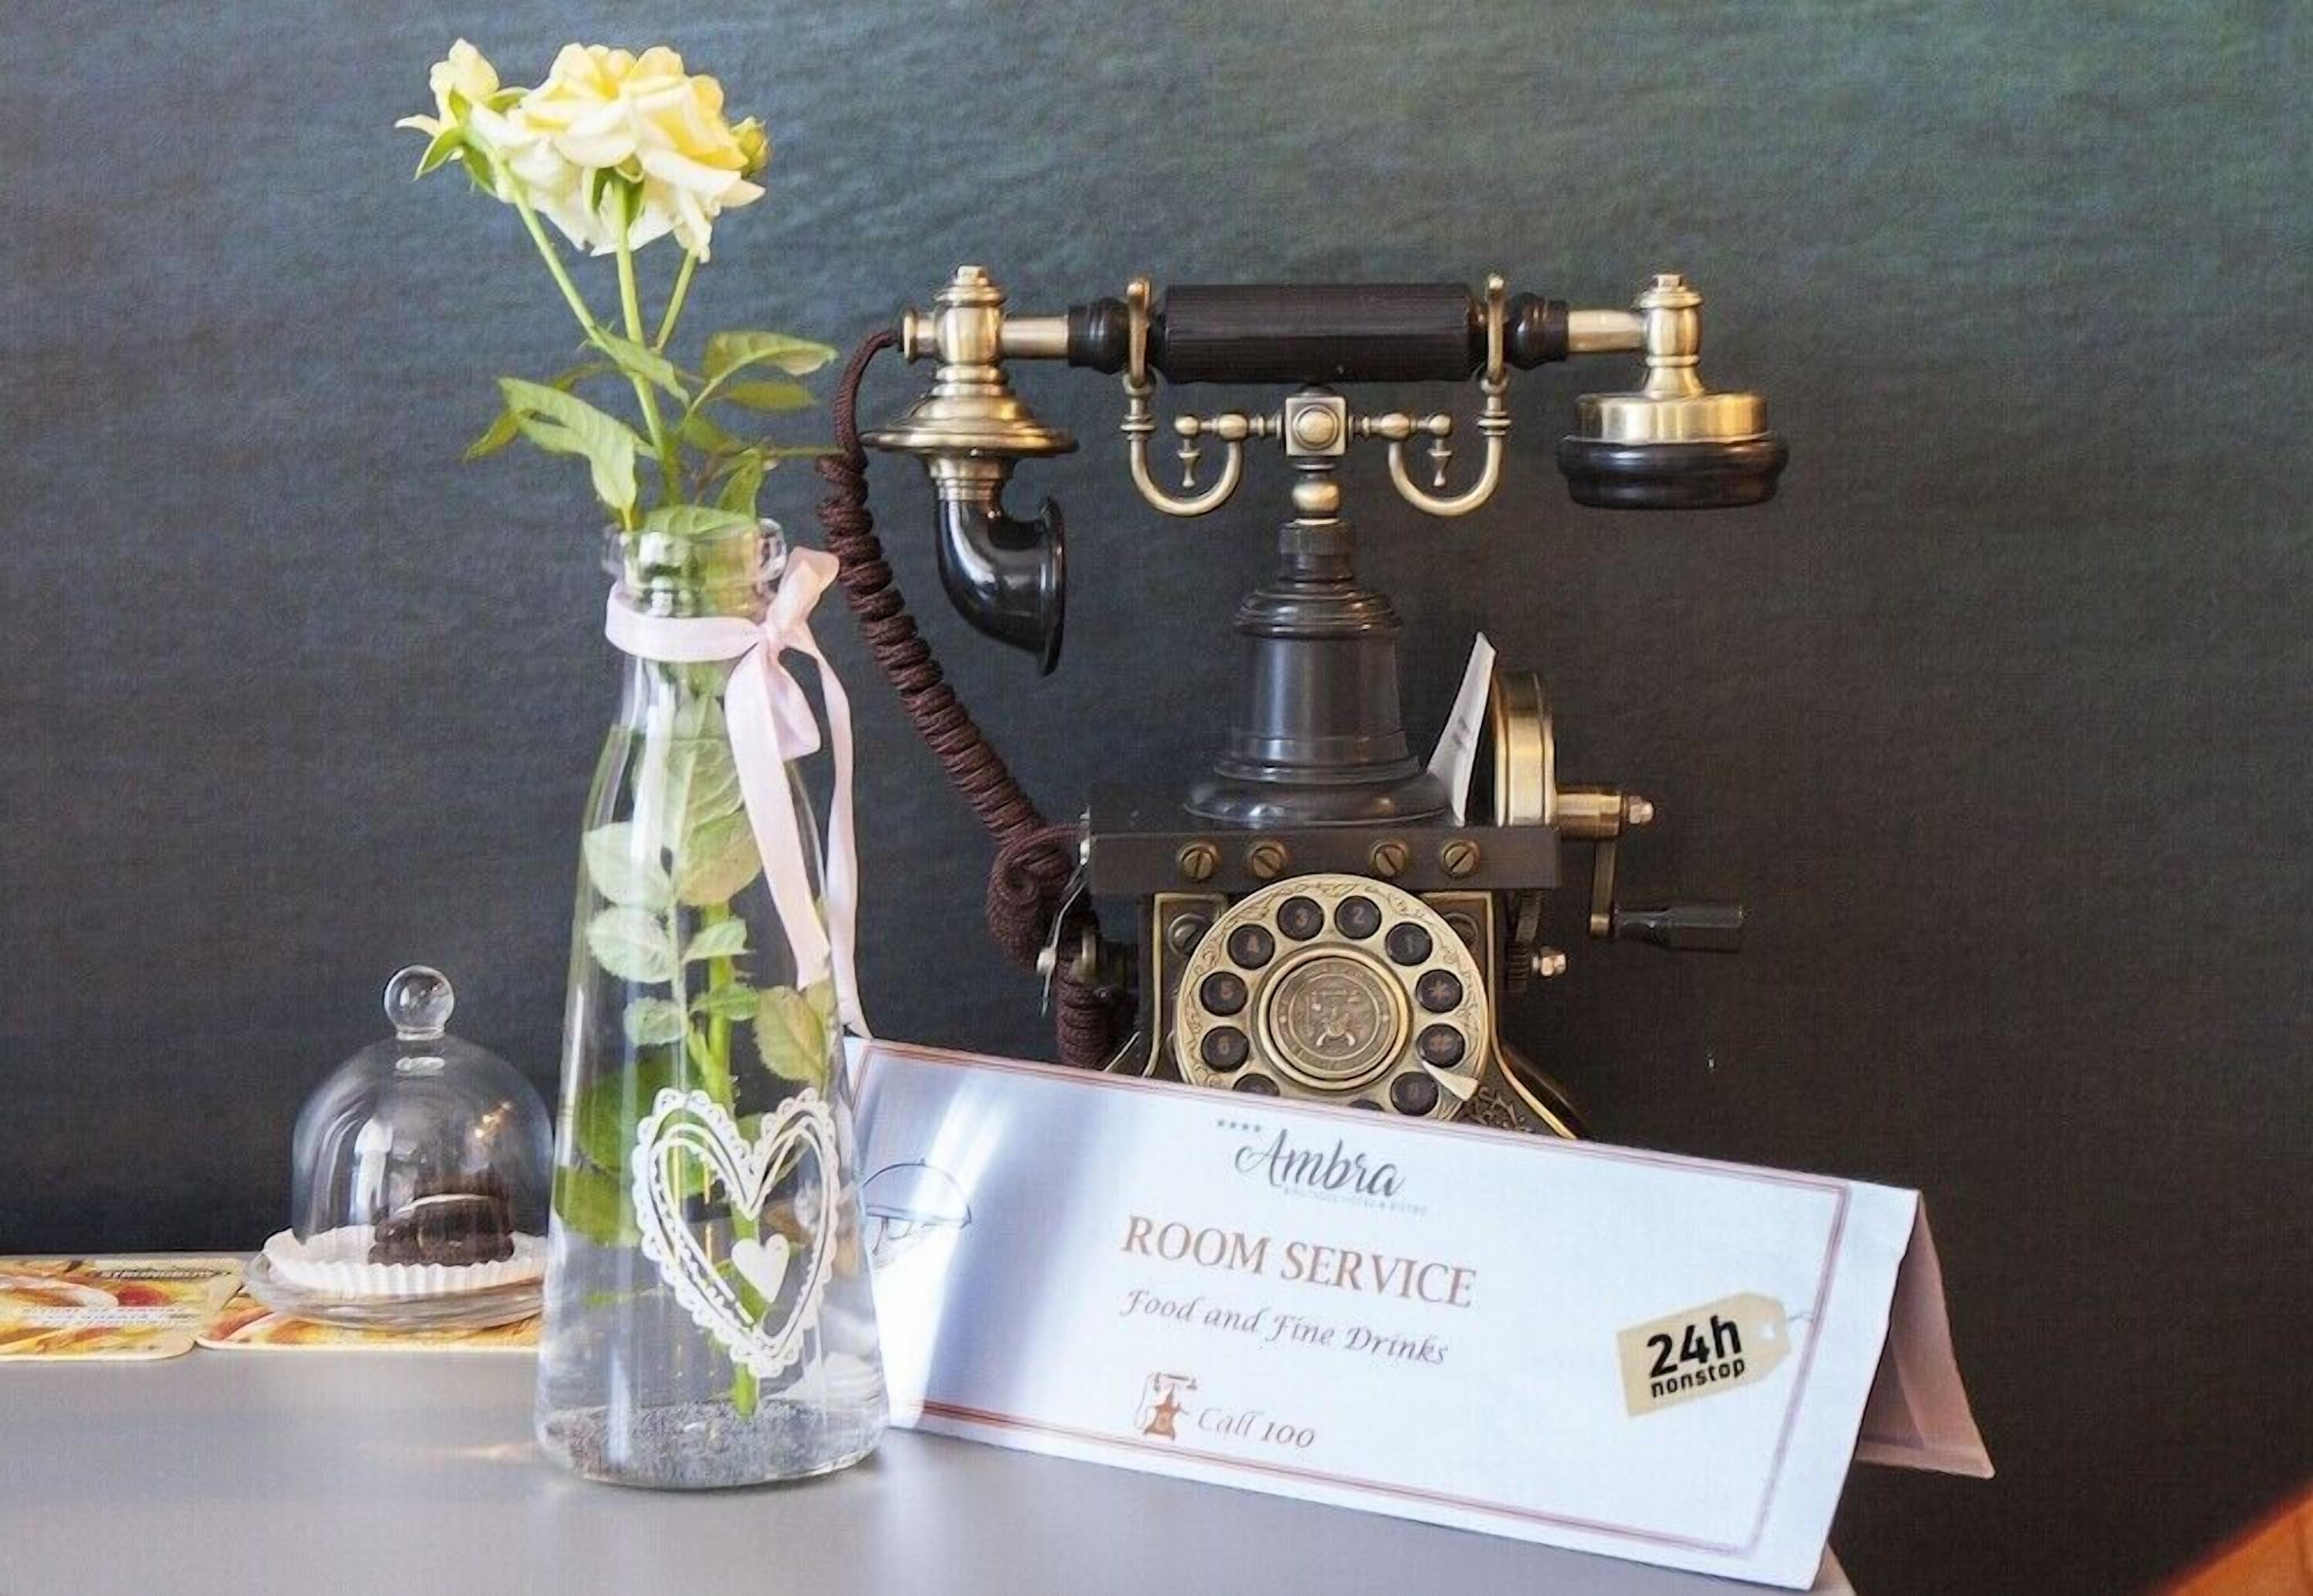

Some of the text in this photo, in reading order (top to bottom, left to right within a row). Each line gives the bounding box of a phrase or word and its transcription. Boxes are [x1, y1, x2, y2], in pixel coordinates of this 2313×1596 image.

[1353, 906, 1365, 925] 2
[1247, 936, 1260, 954] 4
[1235, 1129, 1406, 1196] Ambra
[1121, 1215, 1476, 1307] ROOM SERVICE
[1119, 1290, 1448, 1365] Food and Fine Drinks
[1646, 1314, 1742, 1379] 24h
[1650, 1357, 1746, 1398] nonstop
[1198, 1406, 1315, 1449] Call 100
